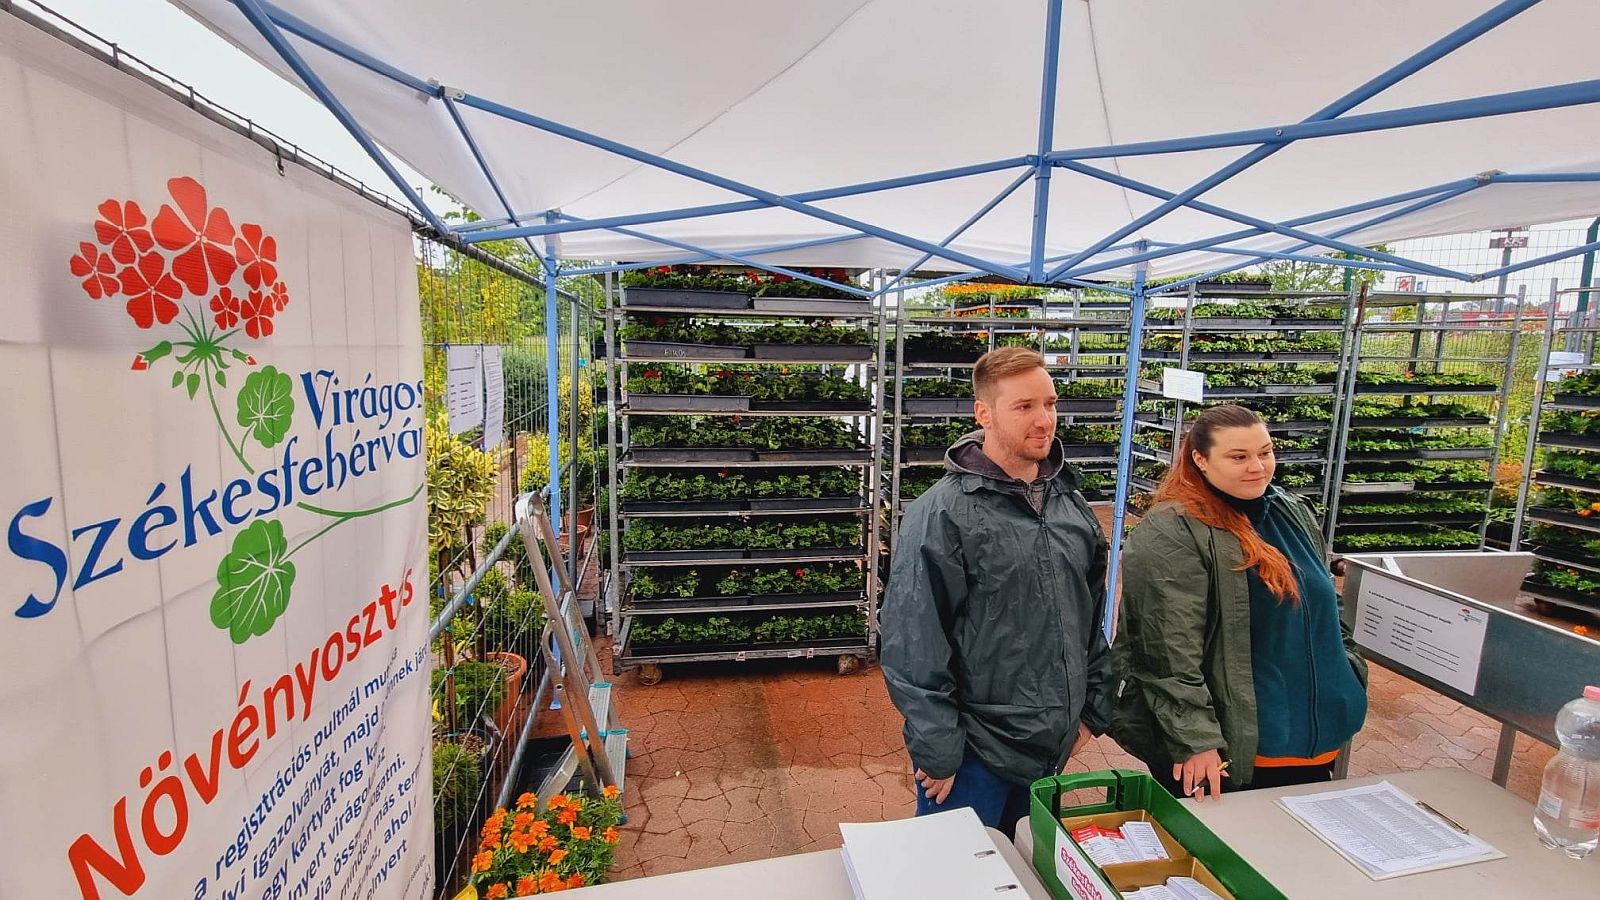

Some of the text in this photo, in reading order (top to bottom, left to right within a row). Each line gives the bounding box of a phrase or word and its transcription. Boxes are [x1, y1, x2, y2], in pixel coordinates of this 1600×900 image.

[67, 567, 414, 900] Növényoszts
[215, 743, 311, 881] regisztrációs
[313, 686, 361, 755] pultnál
[253, 750, 340, 881] igazolványát,
[343, 704, 379, 753] majd
[291, 786, 337, 864] kártyát
[338, 759, 364, 793] fog
[373, 792, 396, 832] más
[382, 800, 412, 844] ahol
[366, 839, 408, 900] elnyert
